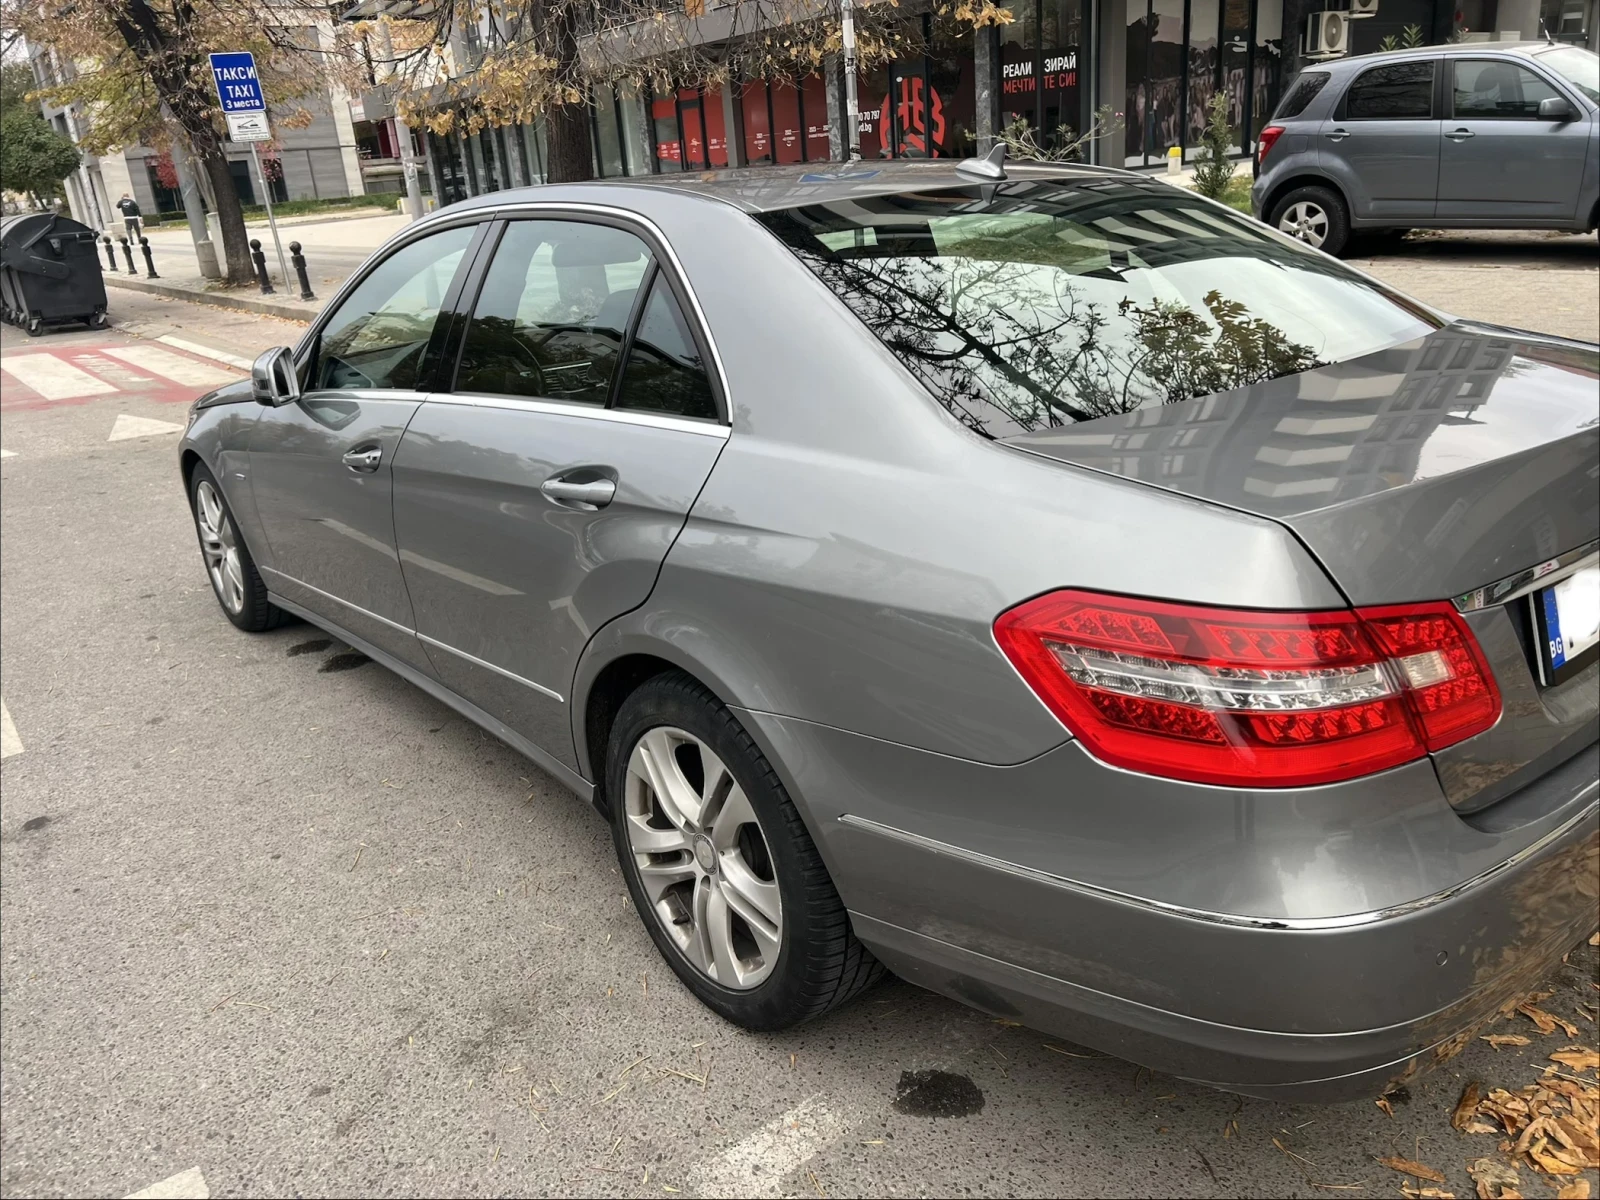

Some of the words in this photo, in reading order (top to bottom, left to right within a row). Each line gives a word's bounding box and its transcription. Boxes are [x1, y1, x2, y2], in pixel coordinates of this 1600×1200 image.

[1003, 61, 1032, 78] РЕАЛИ
[1044, 52, 1076, 72] ЗИРАЙ
[214, 66, 256, 81] ТАКСИ
[1003, 77, 1036, 94] МЕЧТИ
[1043, 75, 1055, 89] ТЕ
[1058, 72, 1076, 87] СИ!
[226, 84, 254, 98] TAXI
[226, 100, 233, 109] 3
[233, 99, 260, 108] места
[863, 111, 870, 120] 70
[870, 110, 880, 119] 797
[1549, 637, 1562, 659] BG
